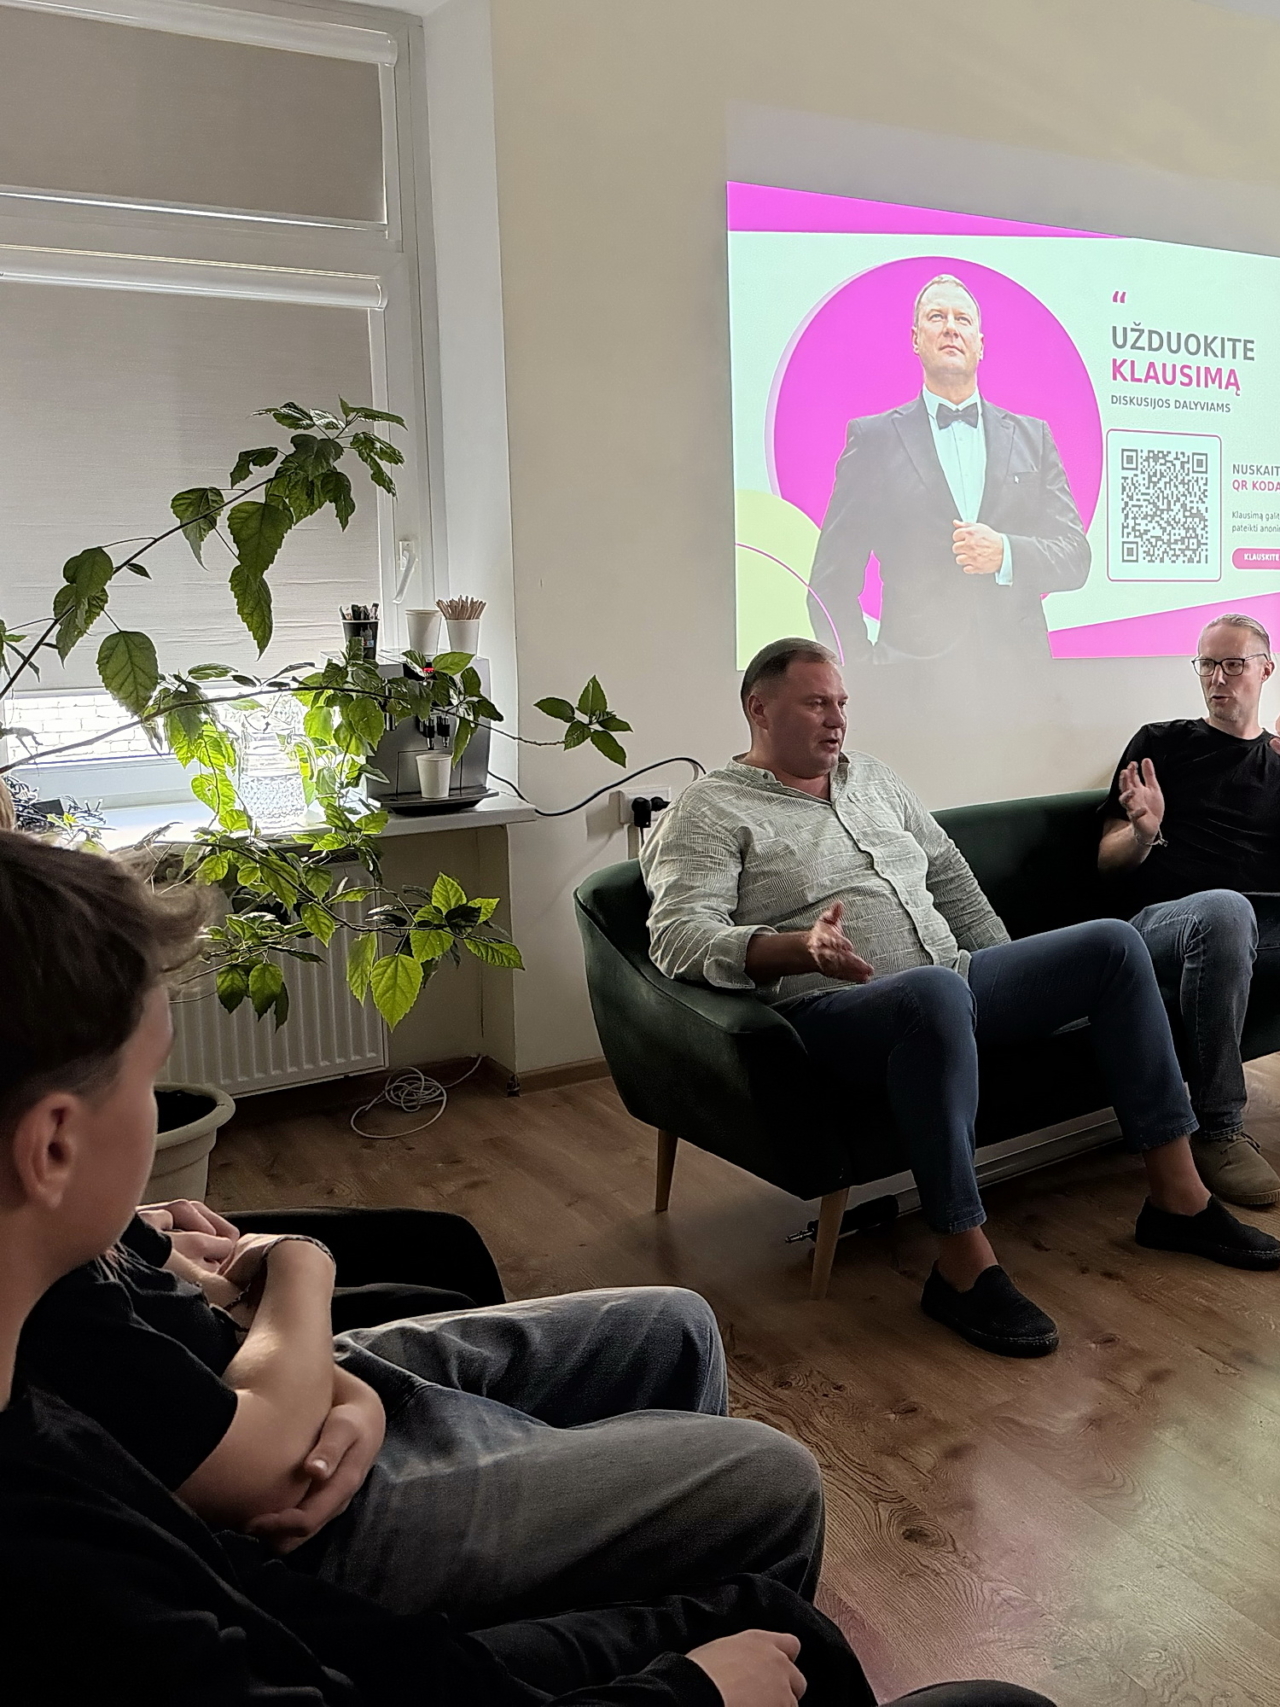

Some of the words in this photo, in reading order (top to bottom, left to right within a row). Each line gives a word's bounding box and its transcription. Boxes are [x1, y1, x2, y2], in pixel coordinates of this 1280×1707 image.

[1111, 322, 1256, 361] UŽDUOKITE
[1111, 358, 1241, 396] KLAUSIMĄ
[1110, 394, 1171, 410] DISKUSIJOS
[1174, 400, 1231, 413] DALYVIAMS
[1232, 479, 1249, 492] QR
[1232, 511, 1263, 522] Klausimą
[1232, 524, 1258, 533] pateikti
